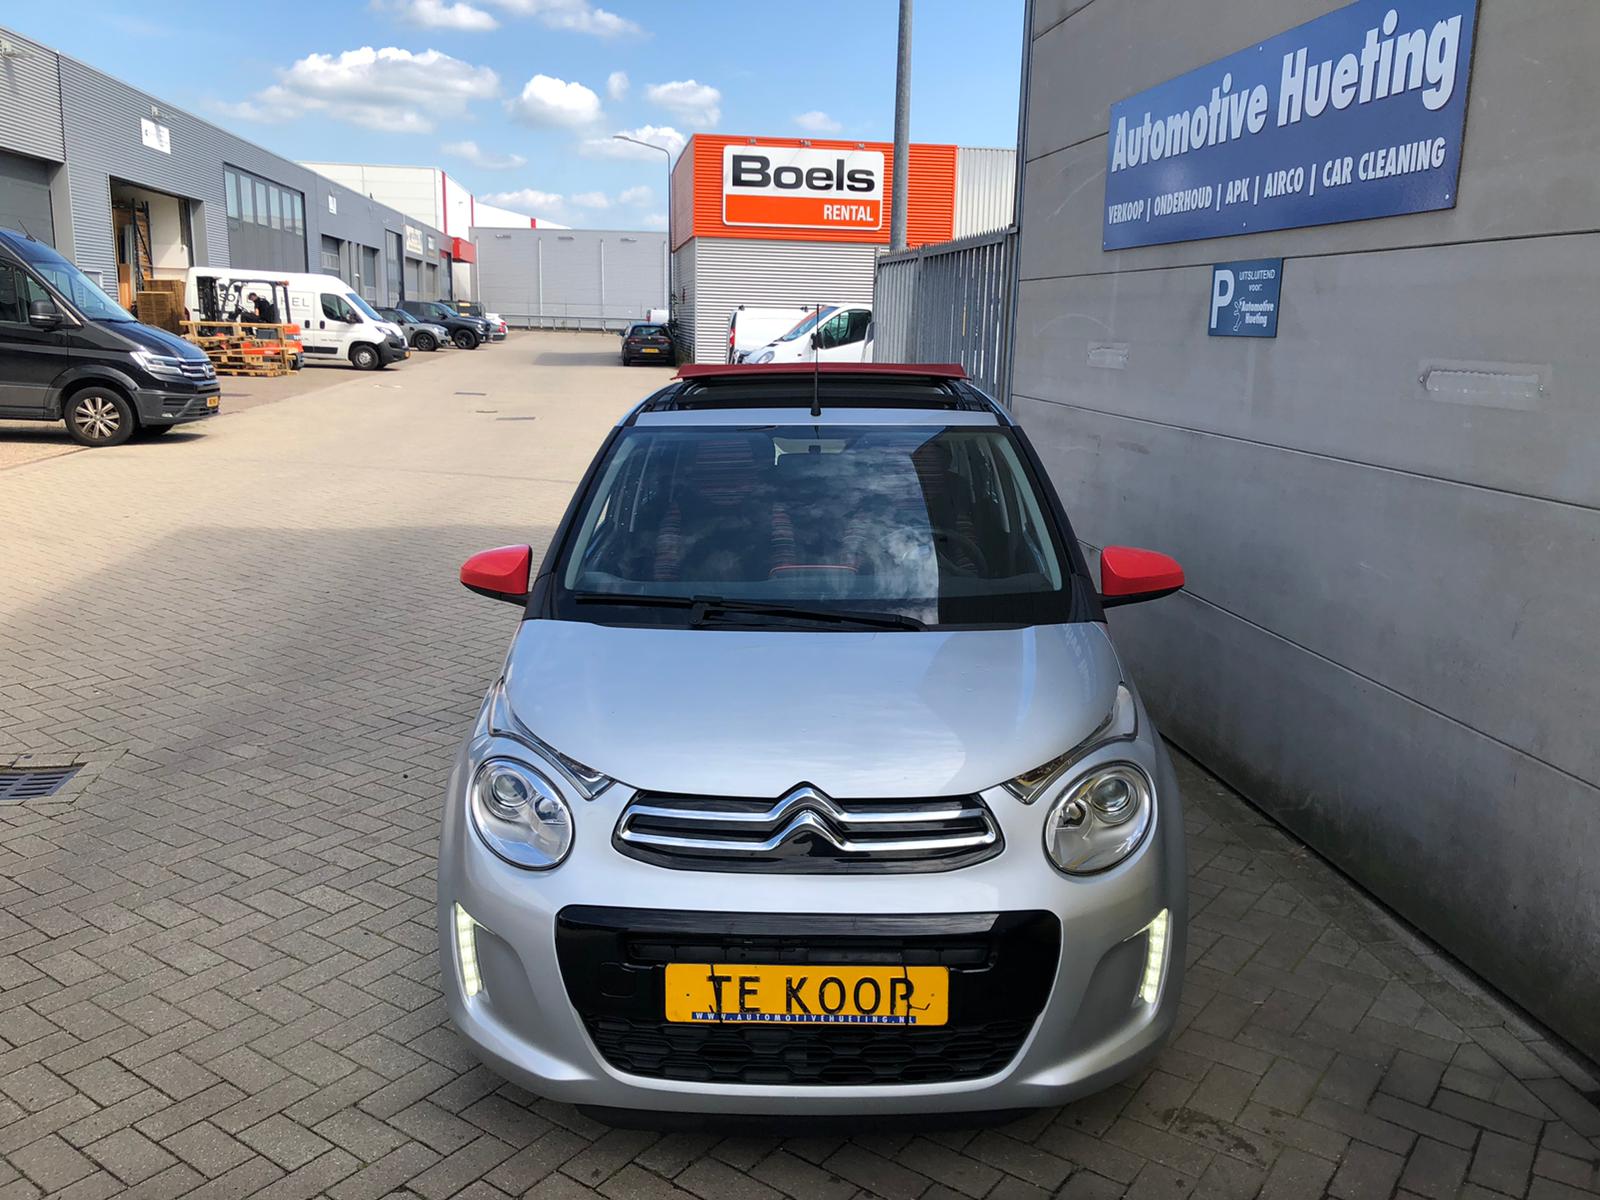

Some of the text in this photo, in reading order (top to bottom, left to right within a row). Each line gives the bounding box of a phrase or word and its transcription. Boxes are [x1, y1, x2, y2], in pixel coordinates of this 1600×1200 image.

[1111, 9, 1462, 173] Automotive Hueting
[732, 154, 875, 193] Boels
[1108, 136, 1446, 225] VERKOOP ONDERHOUD APK AIRCO CAR CLEANING
[823, 204, 874, 222] RENTAL
[1239, 269, 1276, 281] UITSLUITEND
[1210, 269, 1235, 329] P
[1241, 300, 1274, 312] Automotive
[1245, 312, 1268, 327] Hueting
[706, 976, 915, 1015] TE KOOP
